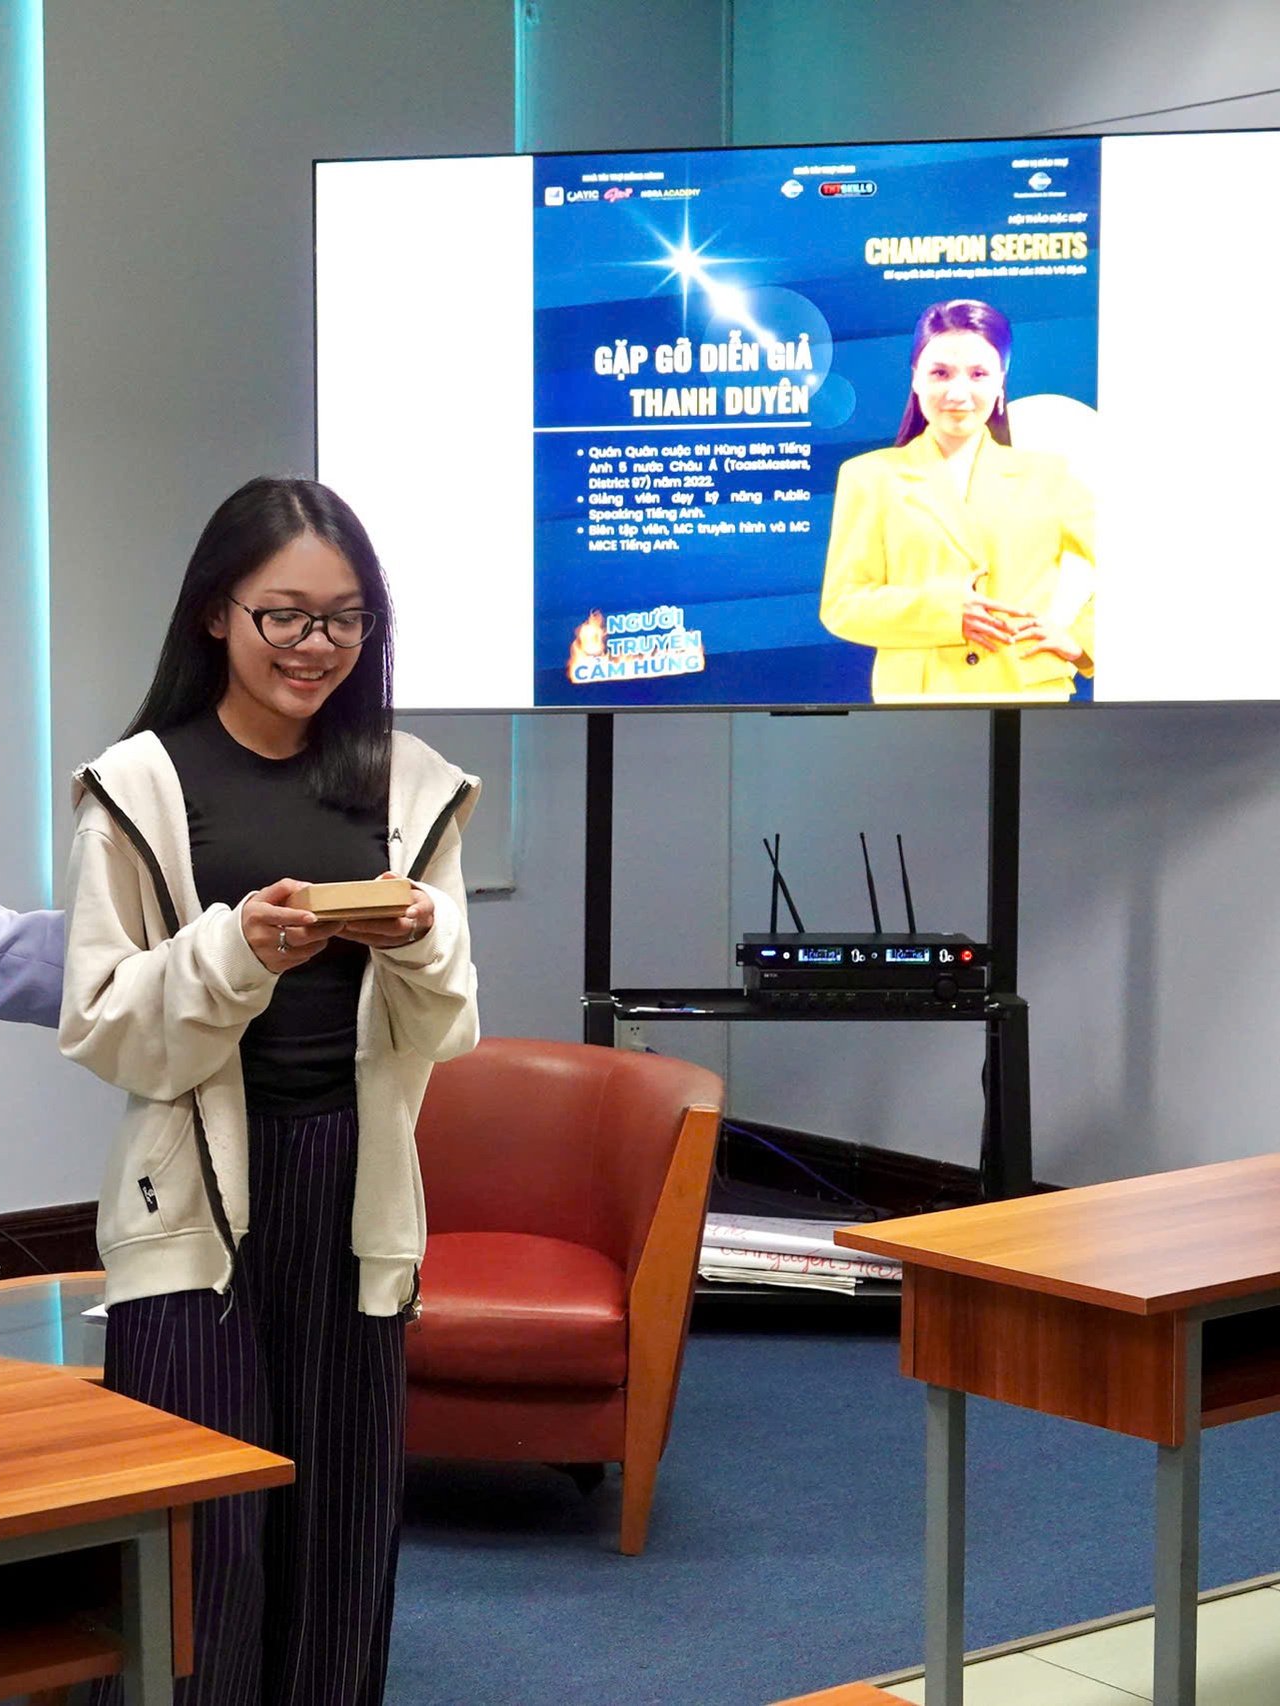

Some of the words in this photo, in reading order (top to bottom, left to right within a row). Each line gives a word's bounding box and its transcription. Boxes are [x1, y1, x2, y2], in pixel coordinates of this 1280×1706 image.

[865, 235, 987, 265] CHAMPION
[990, 231, 1088, 261] SECRETS
[594, 339, 648, 381] GẶP
[700, 330, 759, 372] DIỄN
[767, 333, 813, 370] GIẢ
[630, 387, 717, 417] THANH
[725, 377, 809, 415] DUYÊN
[625, 446, 658, 458] Quân
[695, 445, 710, 455] thi
[779, 442, 810, 456] Tiếng
[589, 462, 612, 473] Anh
[670, 460, 702, 472] Châu
[589, 477, 629, 489] District
[653, 477, 681, 487] năm
[684, 476, 714, 487] 2022.
[589, 493, 623, 507] Giảng
[635, 493, 660, 503] viên
[672, 492, 694, 505] dạy
[731, 491, 762, 504] năng
[774, 489, 810, 501] Public
[589, 509, 643, 522] Speaking
[645, 507, 677, 521] Tiếng
[679, 507, 705, 518] Anh.
[674, 523, 693, 534] MC
[770, 521, 785, 532] và
[790, 521, 810, 532] MC
[589, 540, 617, 551] MICE
[620, 539, 651, 553] Tiếng
[653, 539, 679, 549] Anh.
[574, 658, 626, 680] CẢM
